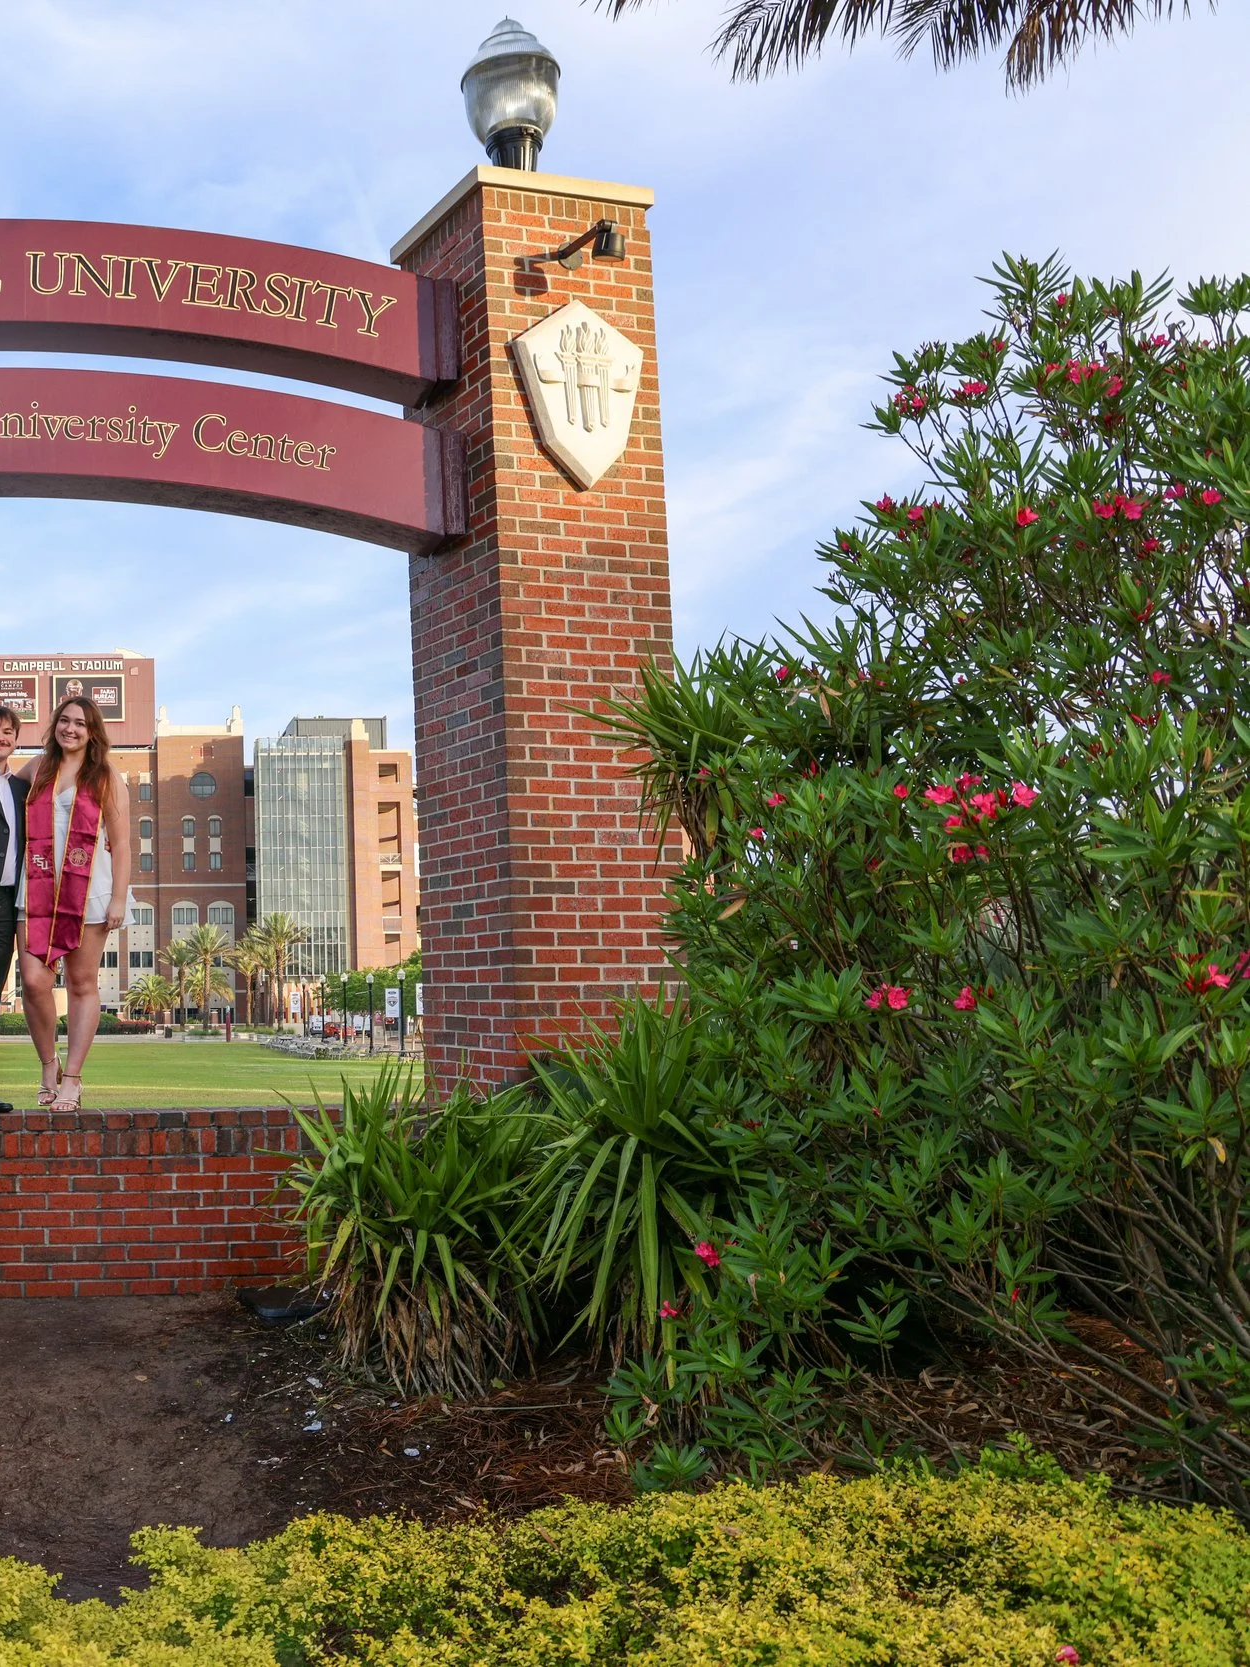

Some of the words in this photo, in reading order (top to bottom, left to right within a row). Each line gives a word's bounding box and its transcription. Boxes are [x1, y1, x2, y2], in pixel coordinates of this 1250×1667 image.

[25, 251, 397, 338] UNIVERSITY
[192, 413, 337, 471] Center
[3, 660, 66, 672] CAMPBELL
[71, 660, 124, 671] STADIUM
[32, 854, 49, 870] FSU
